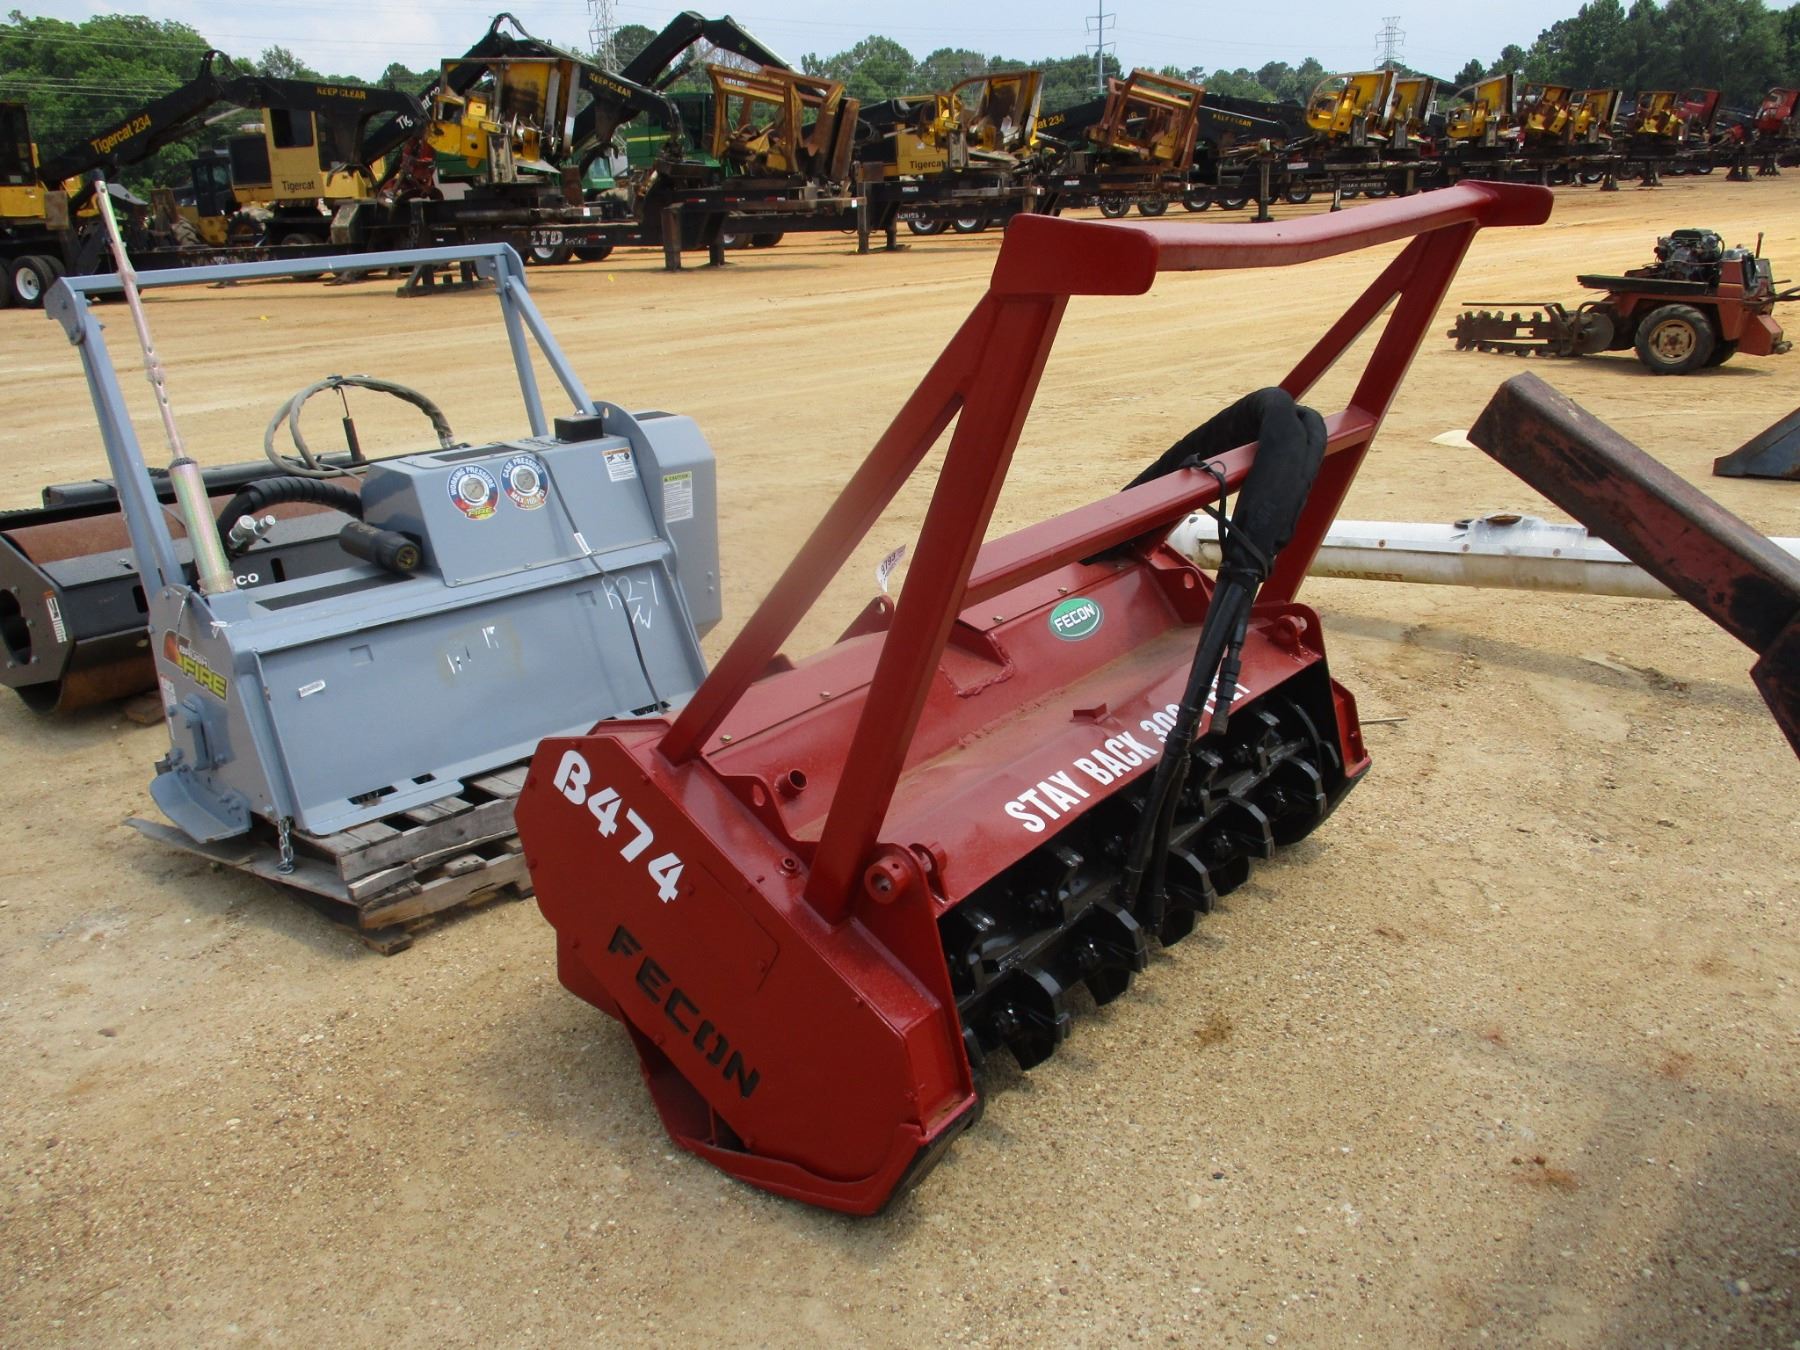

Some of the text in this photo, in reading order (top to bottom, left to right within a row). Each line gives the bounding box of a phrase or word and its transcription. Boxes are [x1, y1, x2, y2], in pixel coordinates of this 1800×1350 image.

[316, 86, 337, 96] KEEP
[91, 114, 152, 153] Tigercat 234
[281, 180, 315, 193] Tigercat
[1053, 603, 1096, 632] FECON
[182, 656, 227, 700] FIRE
[1004, 769, 1091, 833] STAY
[1079, 730, 1159, 787] BACK
[553, 750, 685, 904] B474
[607, 924, 760, 1098] FECON
